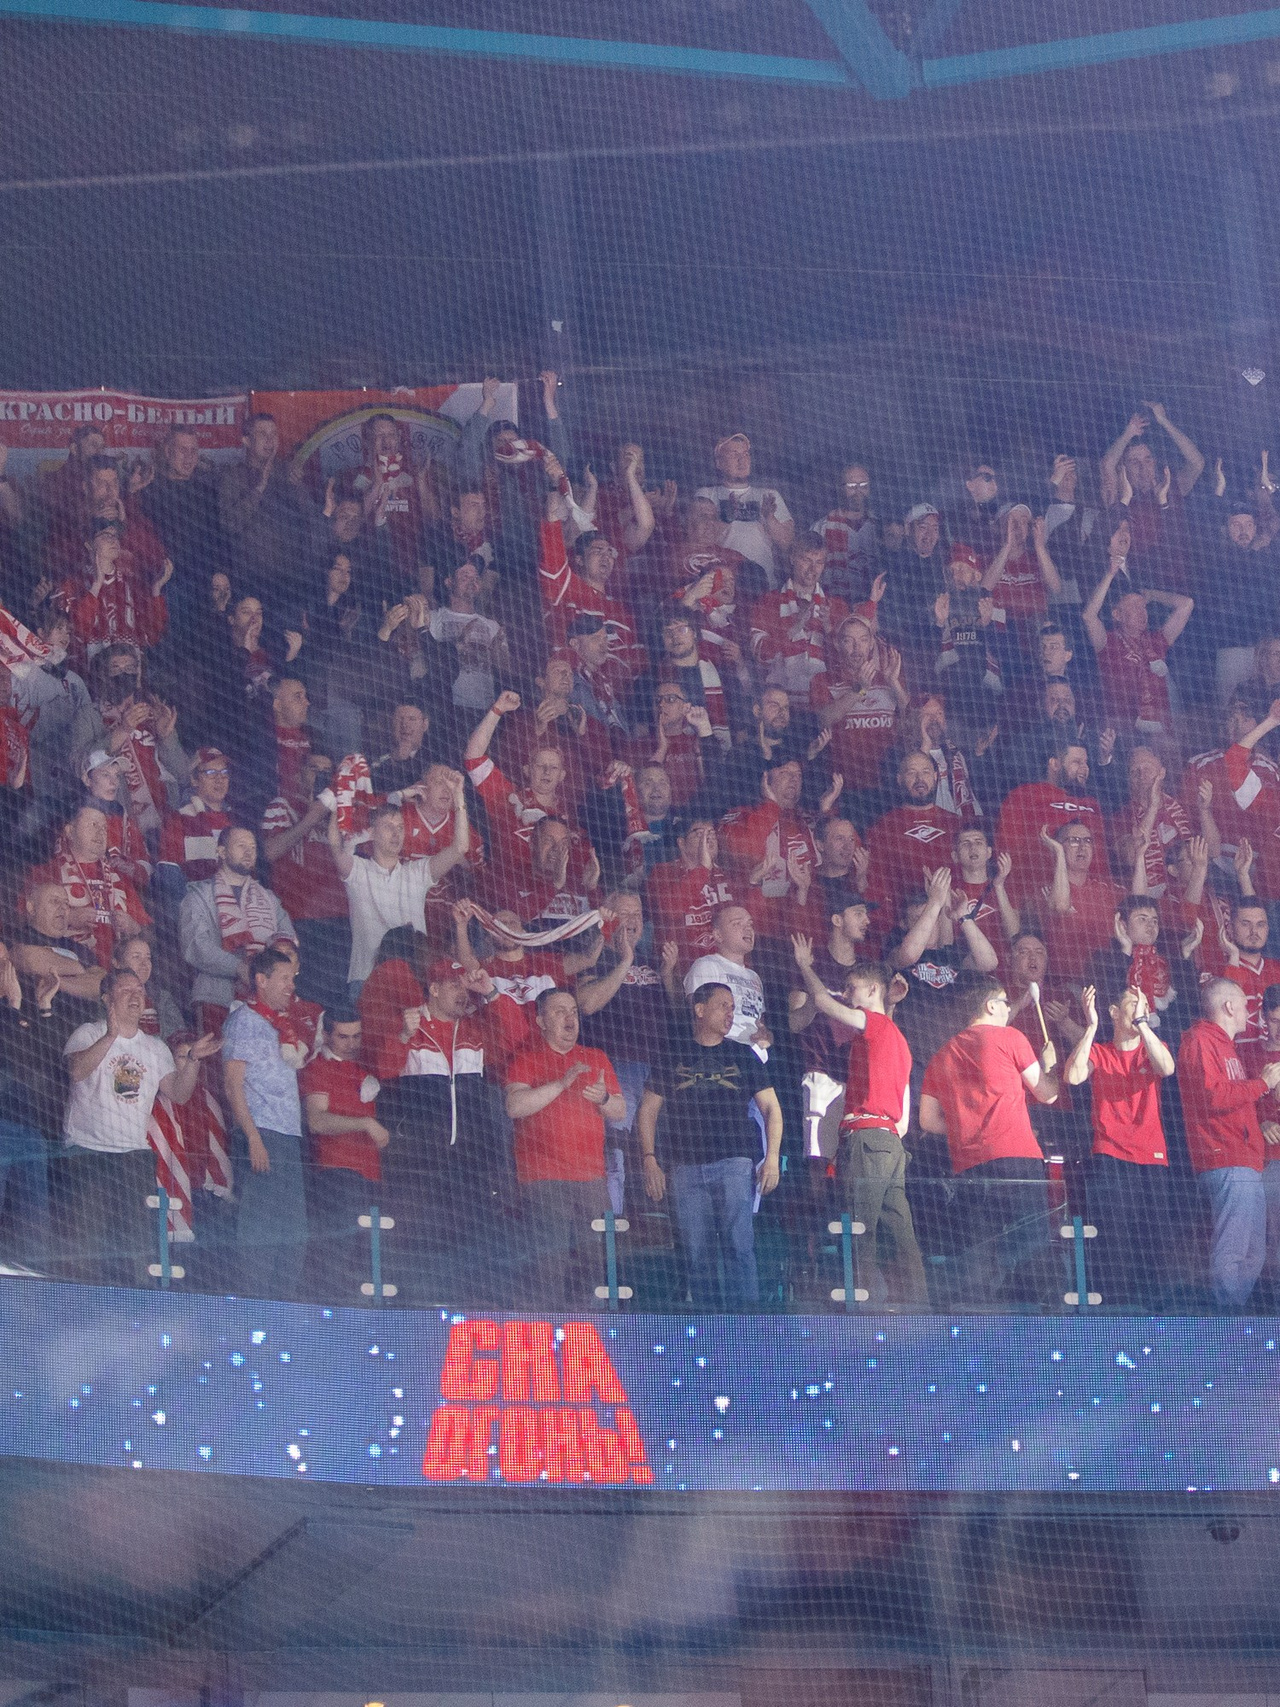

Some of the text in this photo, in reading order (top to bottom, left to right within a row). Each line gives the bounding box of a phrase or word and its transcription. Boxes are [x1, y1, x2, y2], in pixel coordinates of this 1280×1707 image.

[0, 401, 236, 425] КРАСНО-БЕЛЫЙ
[956, 631, 977, 641] 1978
[440, 1320, 629, 1403] СКА
